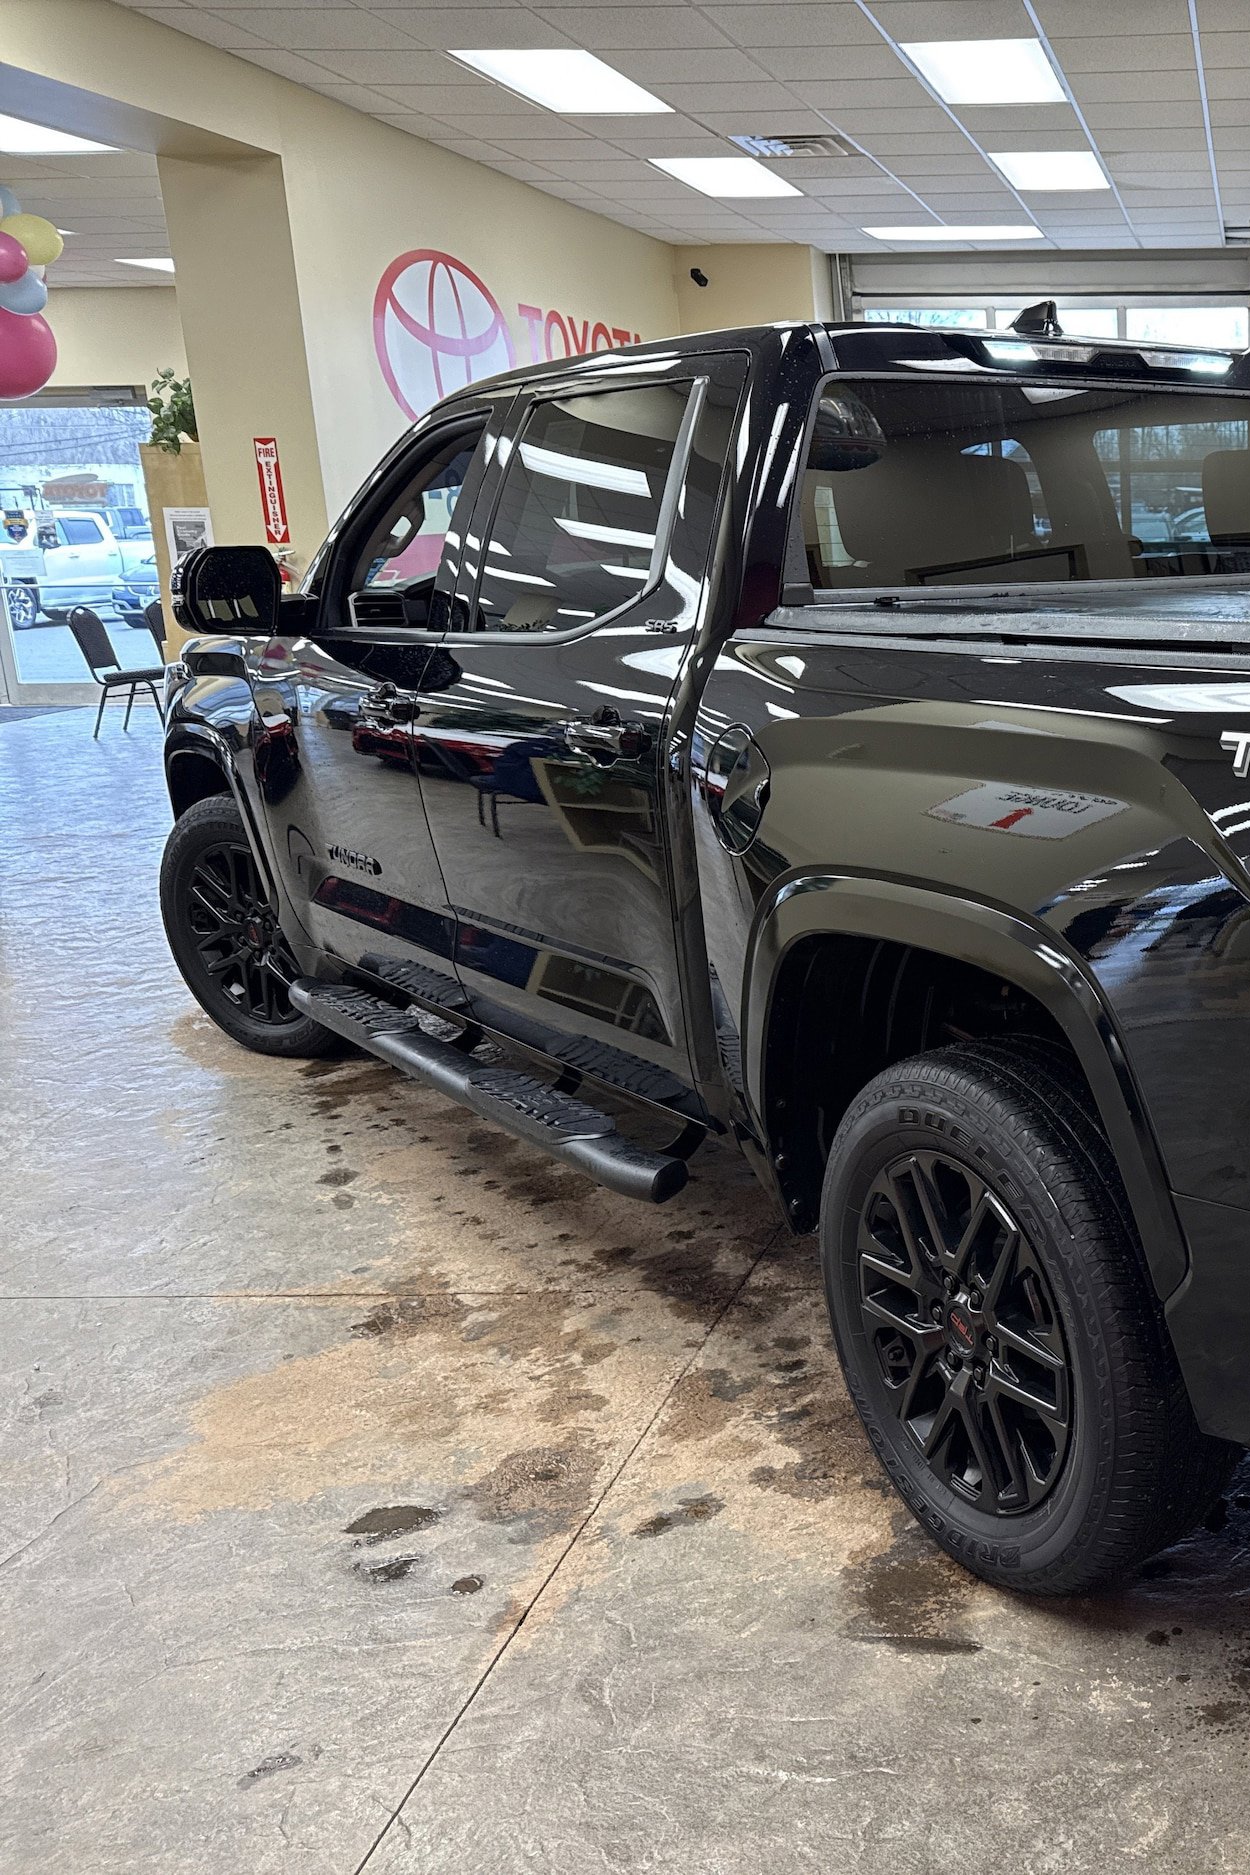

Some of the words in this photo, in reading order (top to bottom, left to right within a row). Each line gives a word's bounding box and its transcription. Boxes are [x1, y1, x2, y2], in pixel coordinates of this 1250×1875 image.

[518, 303, 642, 363] TOYOT
[257, 447, 276, 458] FIRE
[265, 461, 282, 535] EXTINGUISHER
[325, 841, 382, 876] TUNDRA
[897, 1105, 1048, 1245] DUELER
[949, 1311, 974, 1346] TRD
[846, 1368, 1021, 1569] BRIDGESTONE
